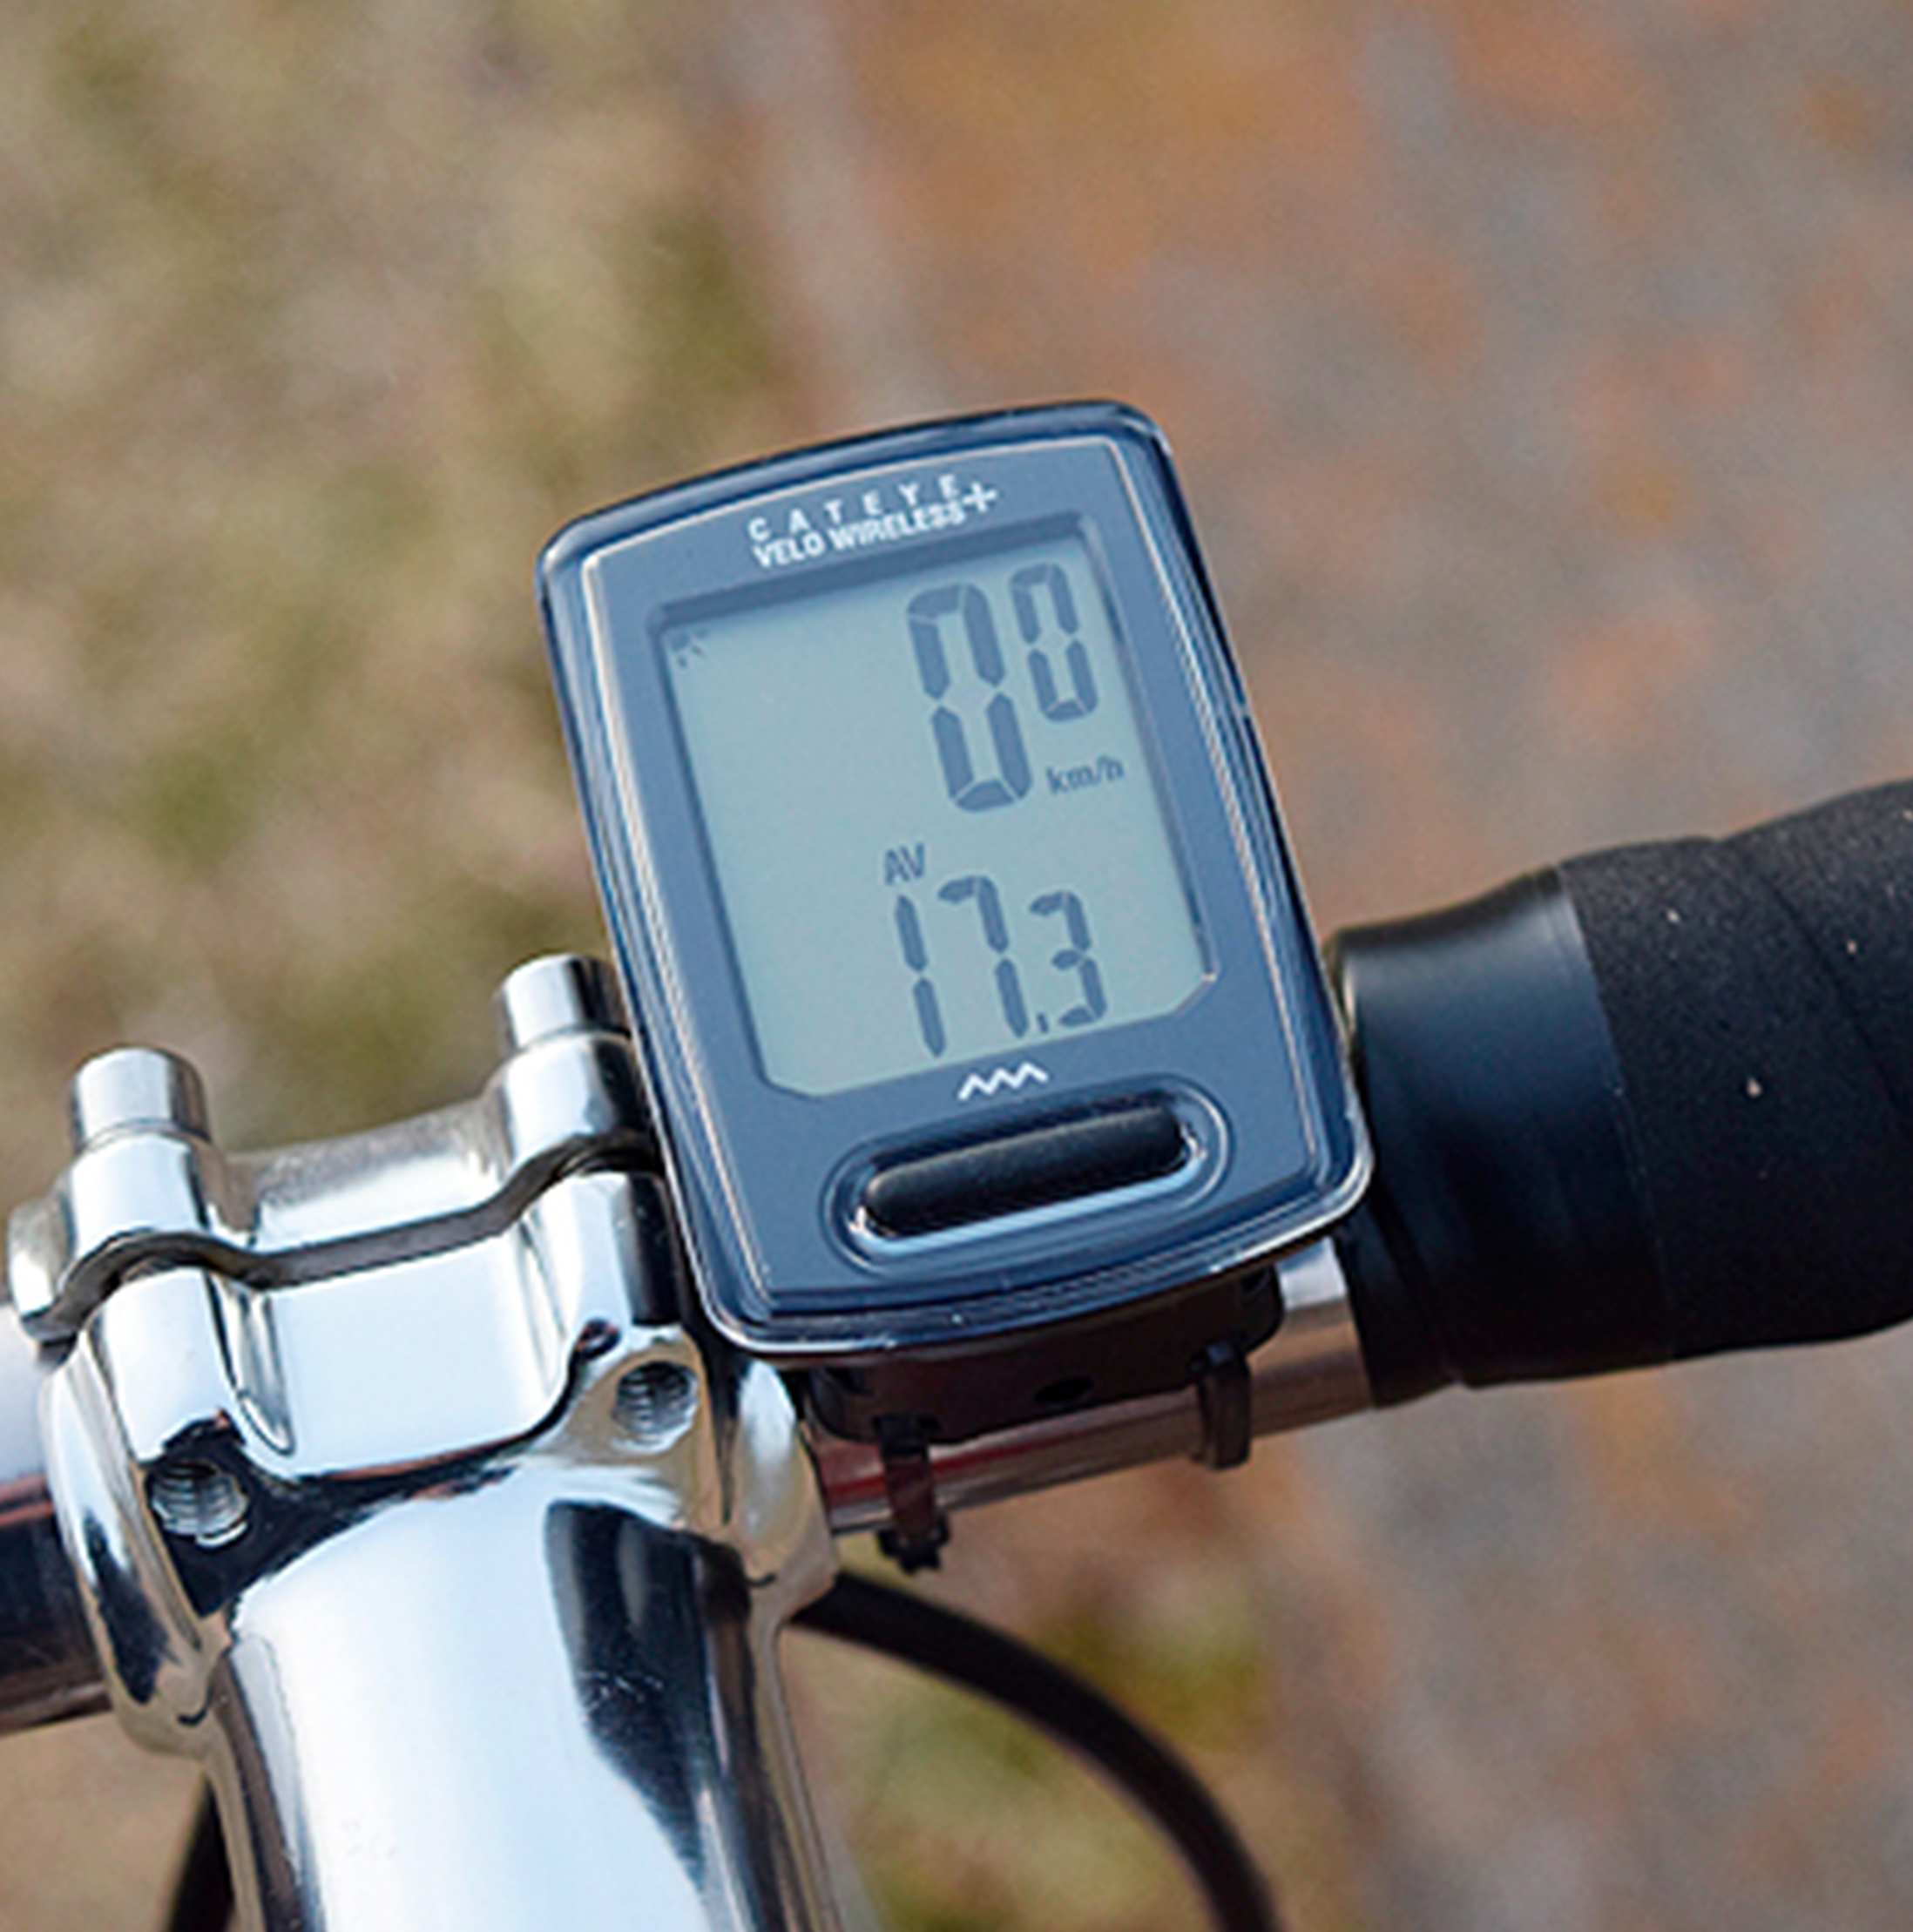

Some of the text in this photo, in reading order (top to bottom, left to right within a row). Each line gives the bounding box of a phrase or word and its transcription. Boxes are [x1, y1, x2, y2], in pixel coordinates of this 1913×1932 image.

[747, 475, 958, 542] CATEYE
[753, 530, 825, 568] VELO
[1044, 754, 1125, 794] km/h
[884, 842, 925, 884] AV
[894, 875, 1106, 1058] 17.3
